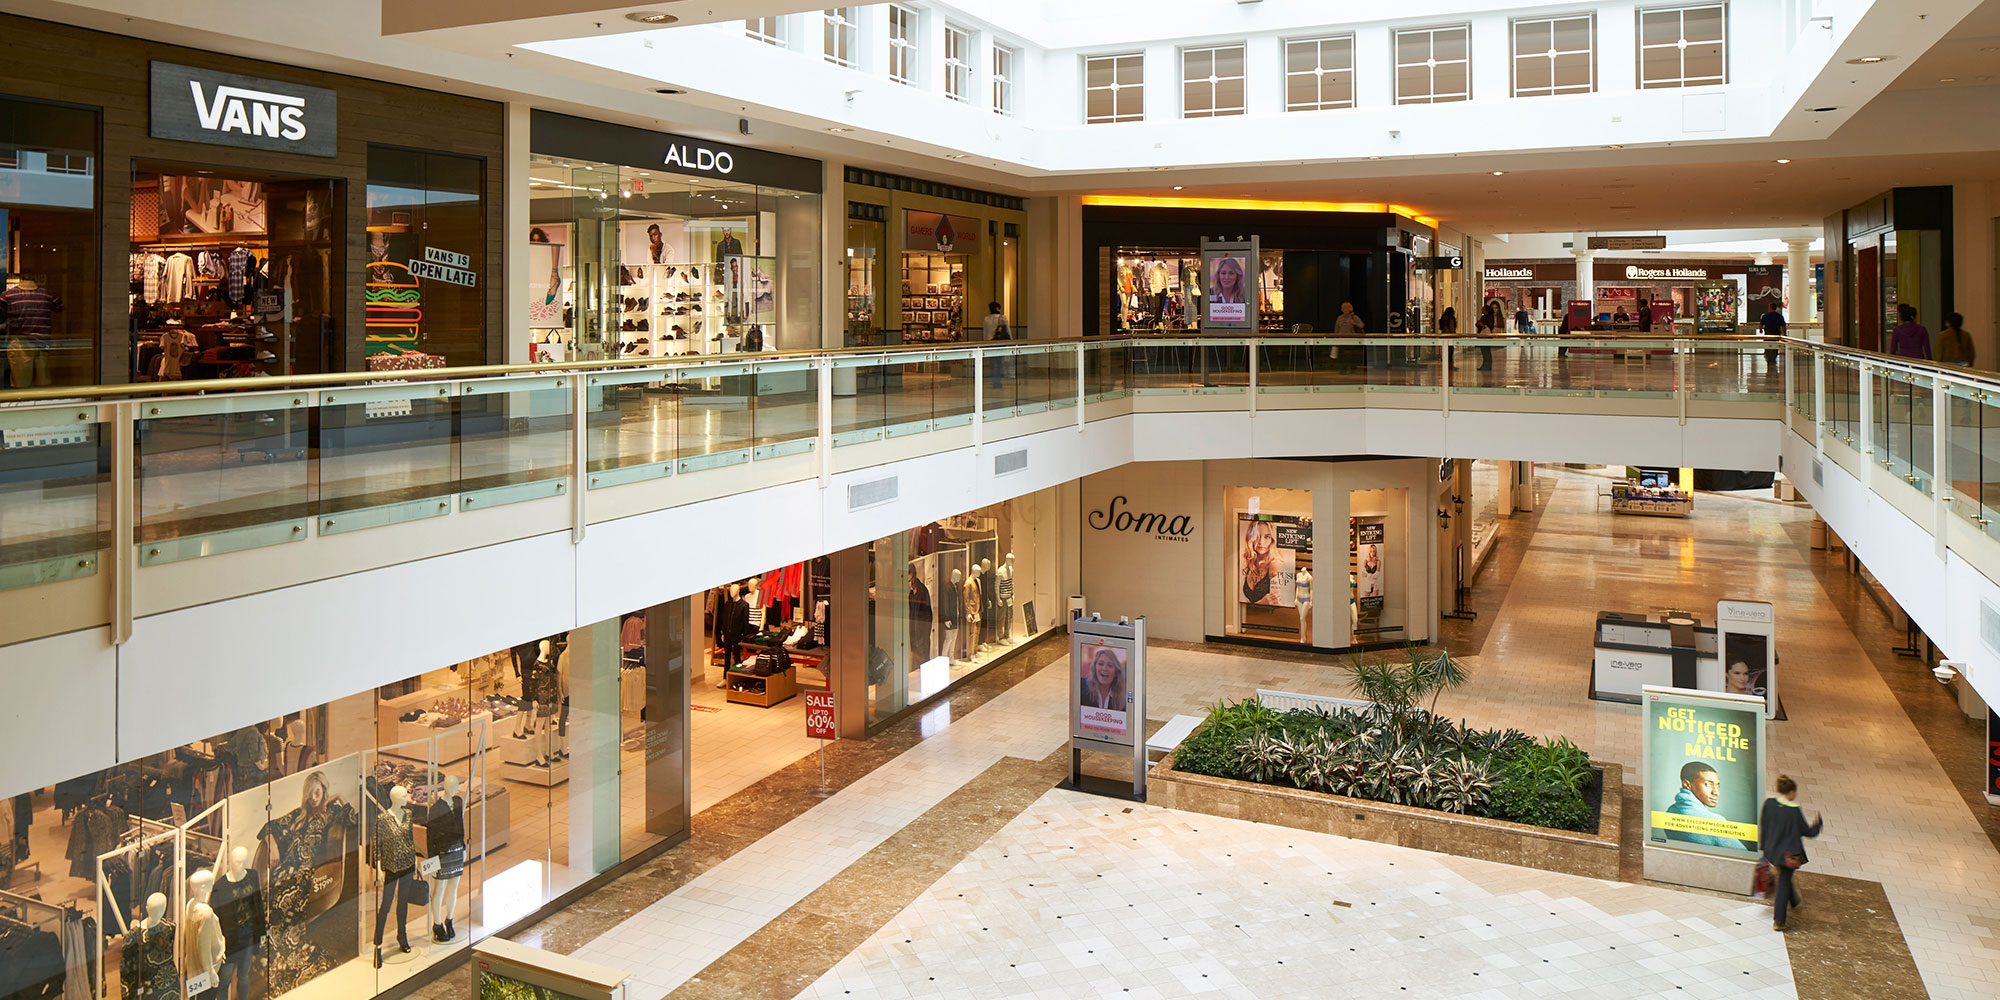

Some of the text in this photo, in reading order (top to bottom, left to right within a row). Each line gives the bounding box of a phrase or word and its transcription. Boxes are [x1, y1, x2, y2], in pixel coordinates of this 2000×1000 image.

[190, 80, 307, 140] VANS
[664, 143, 733, 174] ALDO
[911, 226, 977, 241] GAMERS WORLD
[427, 249, 468, 266] VANS IS
[1450, 257, 1462, 267] G
[411, 261, 475, 286] OPEN LATE
[1485, 268, 1533, 277] Hollands
[1638, 268, 1707, 279] Rogers & Hollands
[1390, 312, 1403, 328] G
[1088, 495, 1195, 536] Soma
[1155, 535, 1189, 543] INTIMATES
[1278, 533, 1306, 541] ENTICING
[757, 561, 804, 609] H&M
[806, 695, 834, 708] SALE
[1084, 714, 1123, 725] HOUSEKEEPING
[1095, 711, 1112, 719] GOOD
[1667, 707, 1697, 720] GET
[807, 714, 835, 730] 60%
[1659, 716, 1742, 738] NOTICED
[1696, 733, 1749, 750] AT THE
[1685, 743, 1737, 762] MALL
[1676, 822, 1709, 832] ADVERTISING
[1710, 827, 1746, 837] POSSIBILITIES
